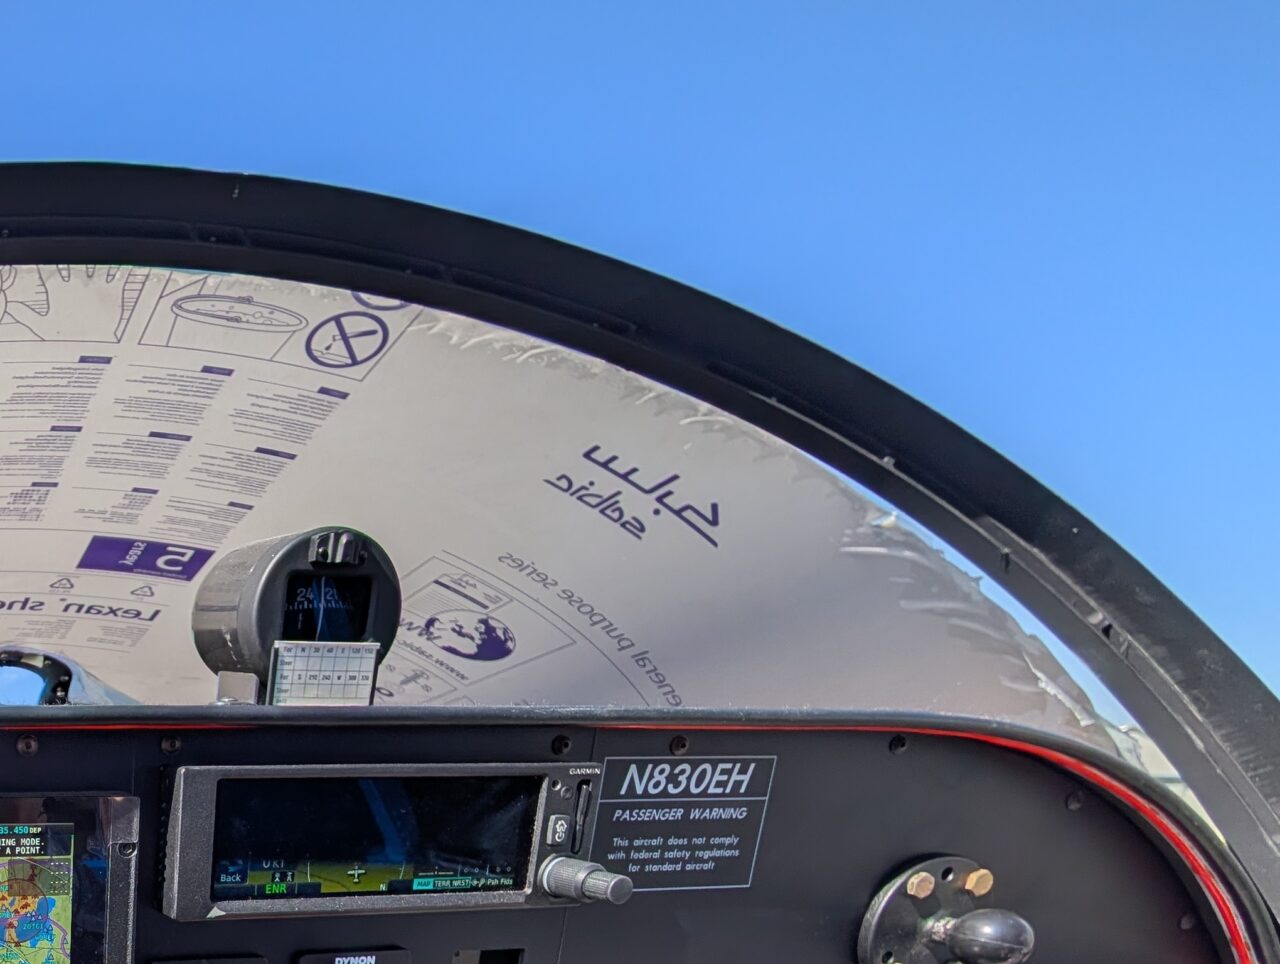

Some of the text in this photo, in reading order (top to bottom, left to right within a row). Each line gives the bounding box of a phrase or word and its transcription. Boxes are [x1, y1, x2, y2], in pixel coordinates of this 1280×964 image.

[569, 767, 601, 775] GARMIN
[620, 762, 756, 795] N830EH
[612, 807, 748, 822] PASSENGER WARNING
[20, 838, 45, 846] MODE.
[612, 835, 740, 847] This aircraft does not comply
[5, 847, 12, 855] A
[15, 846, 44, 855] POINT.
[607, 848, 740, 860] with federal safety regulations
[628, 861, 716, 873] for standard aircraft
[220, 874, 241, 882] Back
[265, 883, 287, 894] ENR
